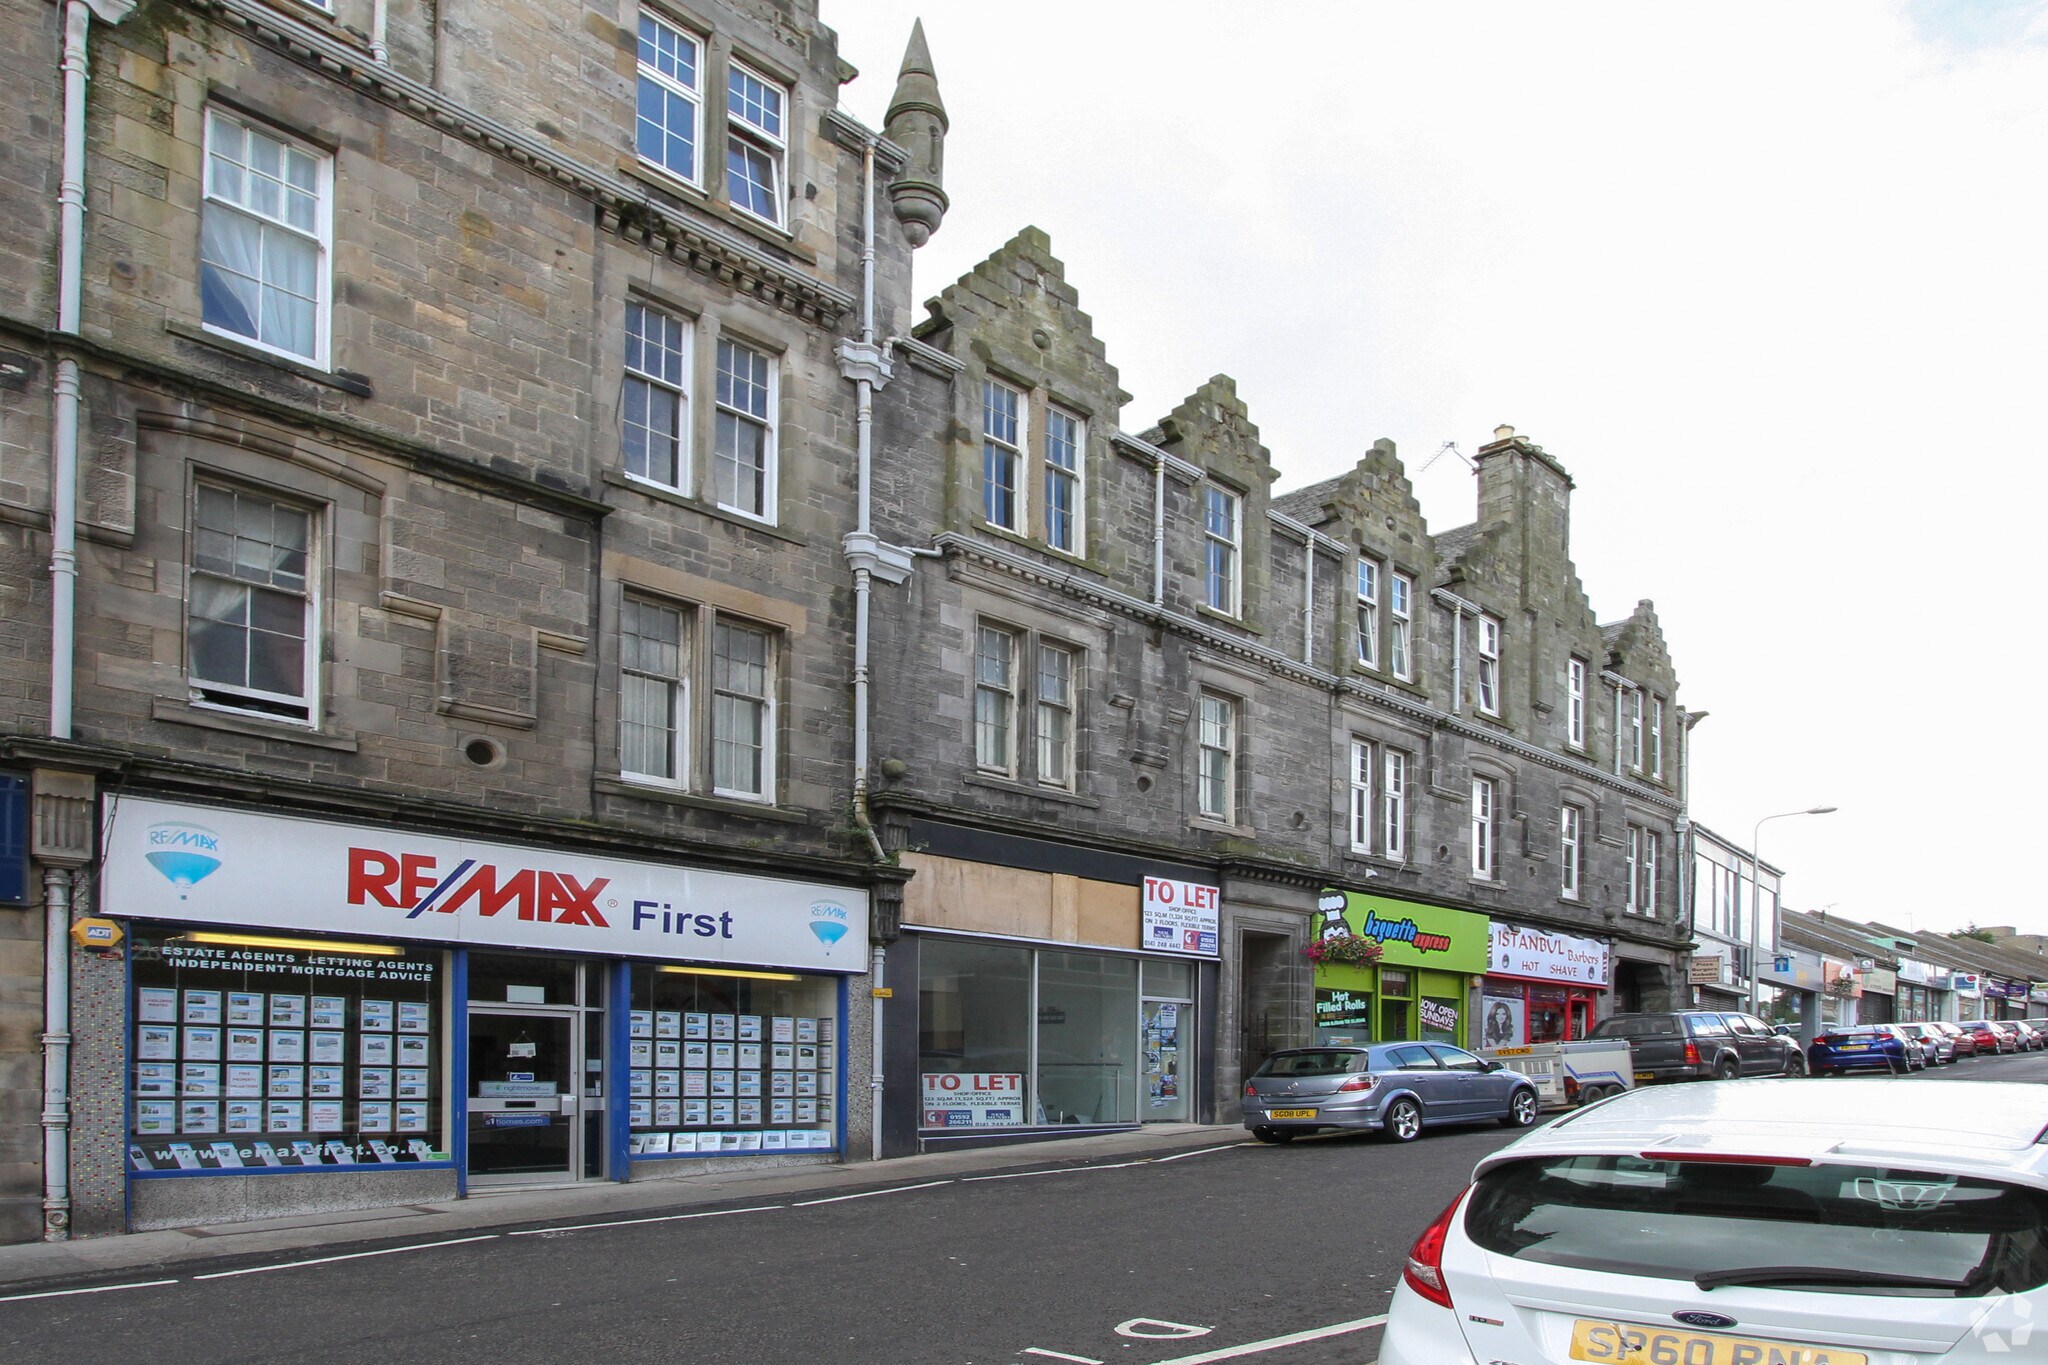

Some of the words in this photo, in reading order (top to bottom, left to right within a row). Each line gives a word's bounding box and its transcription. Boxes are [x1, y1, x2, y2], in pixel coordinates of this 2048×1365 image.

[150, 830, 218, 851] RE/MAX
[347, 847, 611, 928] RE/MAX
[632, 900, 733, 939] First
[1145, 879, 1175, 904] TO
[1183, 884, 1218, 910] LET
[811, 906, 847, 920] RE/MAX
[88, 928, 111, 938] ADT
[1364, 910, 1417, 943] baguette
[1413, 933, 1450, 953] express
[1497, 930, 1564, 955] ISTANBUL
[1567, 949, 1599, 965] Barbers
[162, 946, 226, 959] ESTATE
[231, 951, 295, 963] AGENTS
[308, 956, 373, 968] LETTING
[377, 960, 434, 972] AGENTS
[169, 958, 287, 973] INDEPENDENT
[291, 965, 376, 979] MORTGAGE
[379, 971, 432, 982] ADVICE
[1522, 961, 1539, 972] HOT
[1550, 965, 1577, 977] SHAVE
[1332, 991, 1350, 1002] Hot
[1316, 1001, 1342, 1014] Filled
[1344, 999, 1366, 1011] Rolls
[1438, 1005, 1459, 1020] OPEN
[1420, 1008, 1454, 1027] SUNDAYS
[924, 1074, 961, 1091] TO
[973, 1074, 1020, 1091] LET
[1273, 1110, 1294, 1118] SG08
[1295, 1109, 1311, 1117] UPL
[1686, 1313, 1721, 1326] Ford
[1586, 1327, 1714, 1365] SP60
